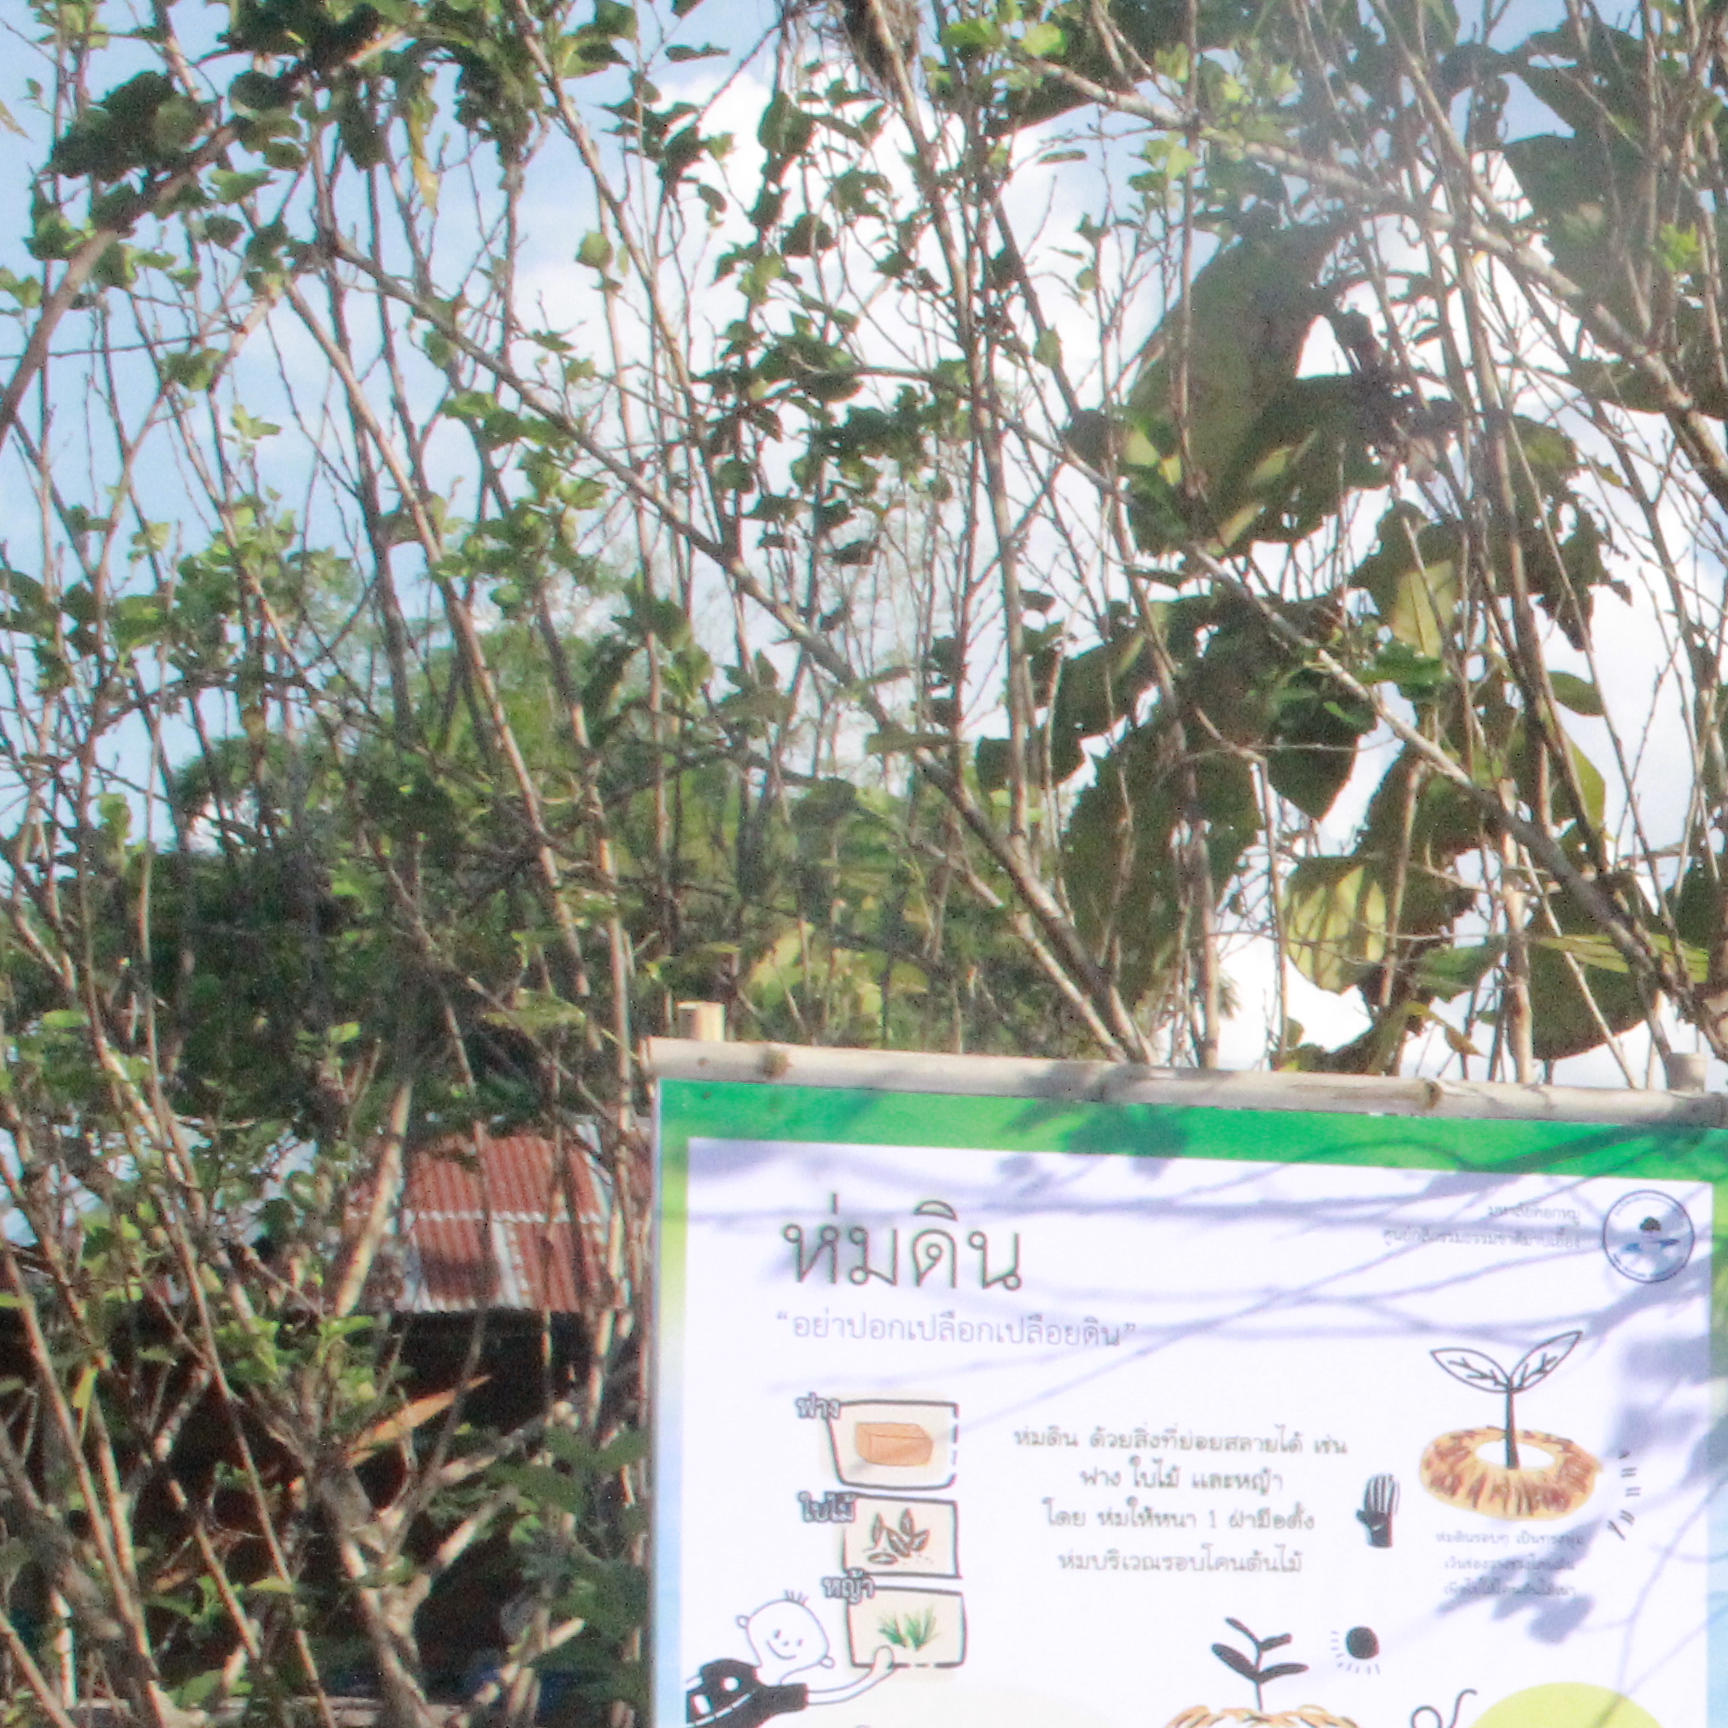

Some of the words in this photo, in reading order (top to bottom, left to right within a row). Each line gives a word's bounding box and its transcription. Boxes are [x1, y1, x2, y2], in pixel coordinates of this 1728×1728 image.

[782, 1193, 1021, 1291] ห่มดิน
[795, 1391, 842, 1419] ฟาง
[1014, 1425, 1079, 1448] ห่มดิน
[1314, 1432, 1348, 1455] เช่น
[1080, 1465, 1121, 1488] ฟาง
[1129, 1455, 1181, 1489] ใบไม้
[1192, 1465, 1283, 1496] และหญ้า
[797, 1490, 857, 1522] ใบไม้
[1042, 1496, 1086, 1528] โดย
[1097, 1496, 1197, 1529] ห่มให้หนา
[1208, 1509, 1218, 1529] 1
[1058, 1543, 1303, 1573] ห่มบริเวณรอบโคนต้นไม้
[821, 1566, 875, 1605] หญ้า
